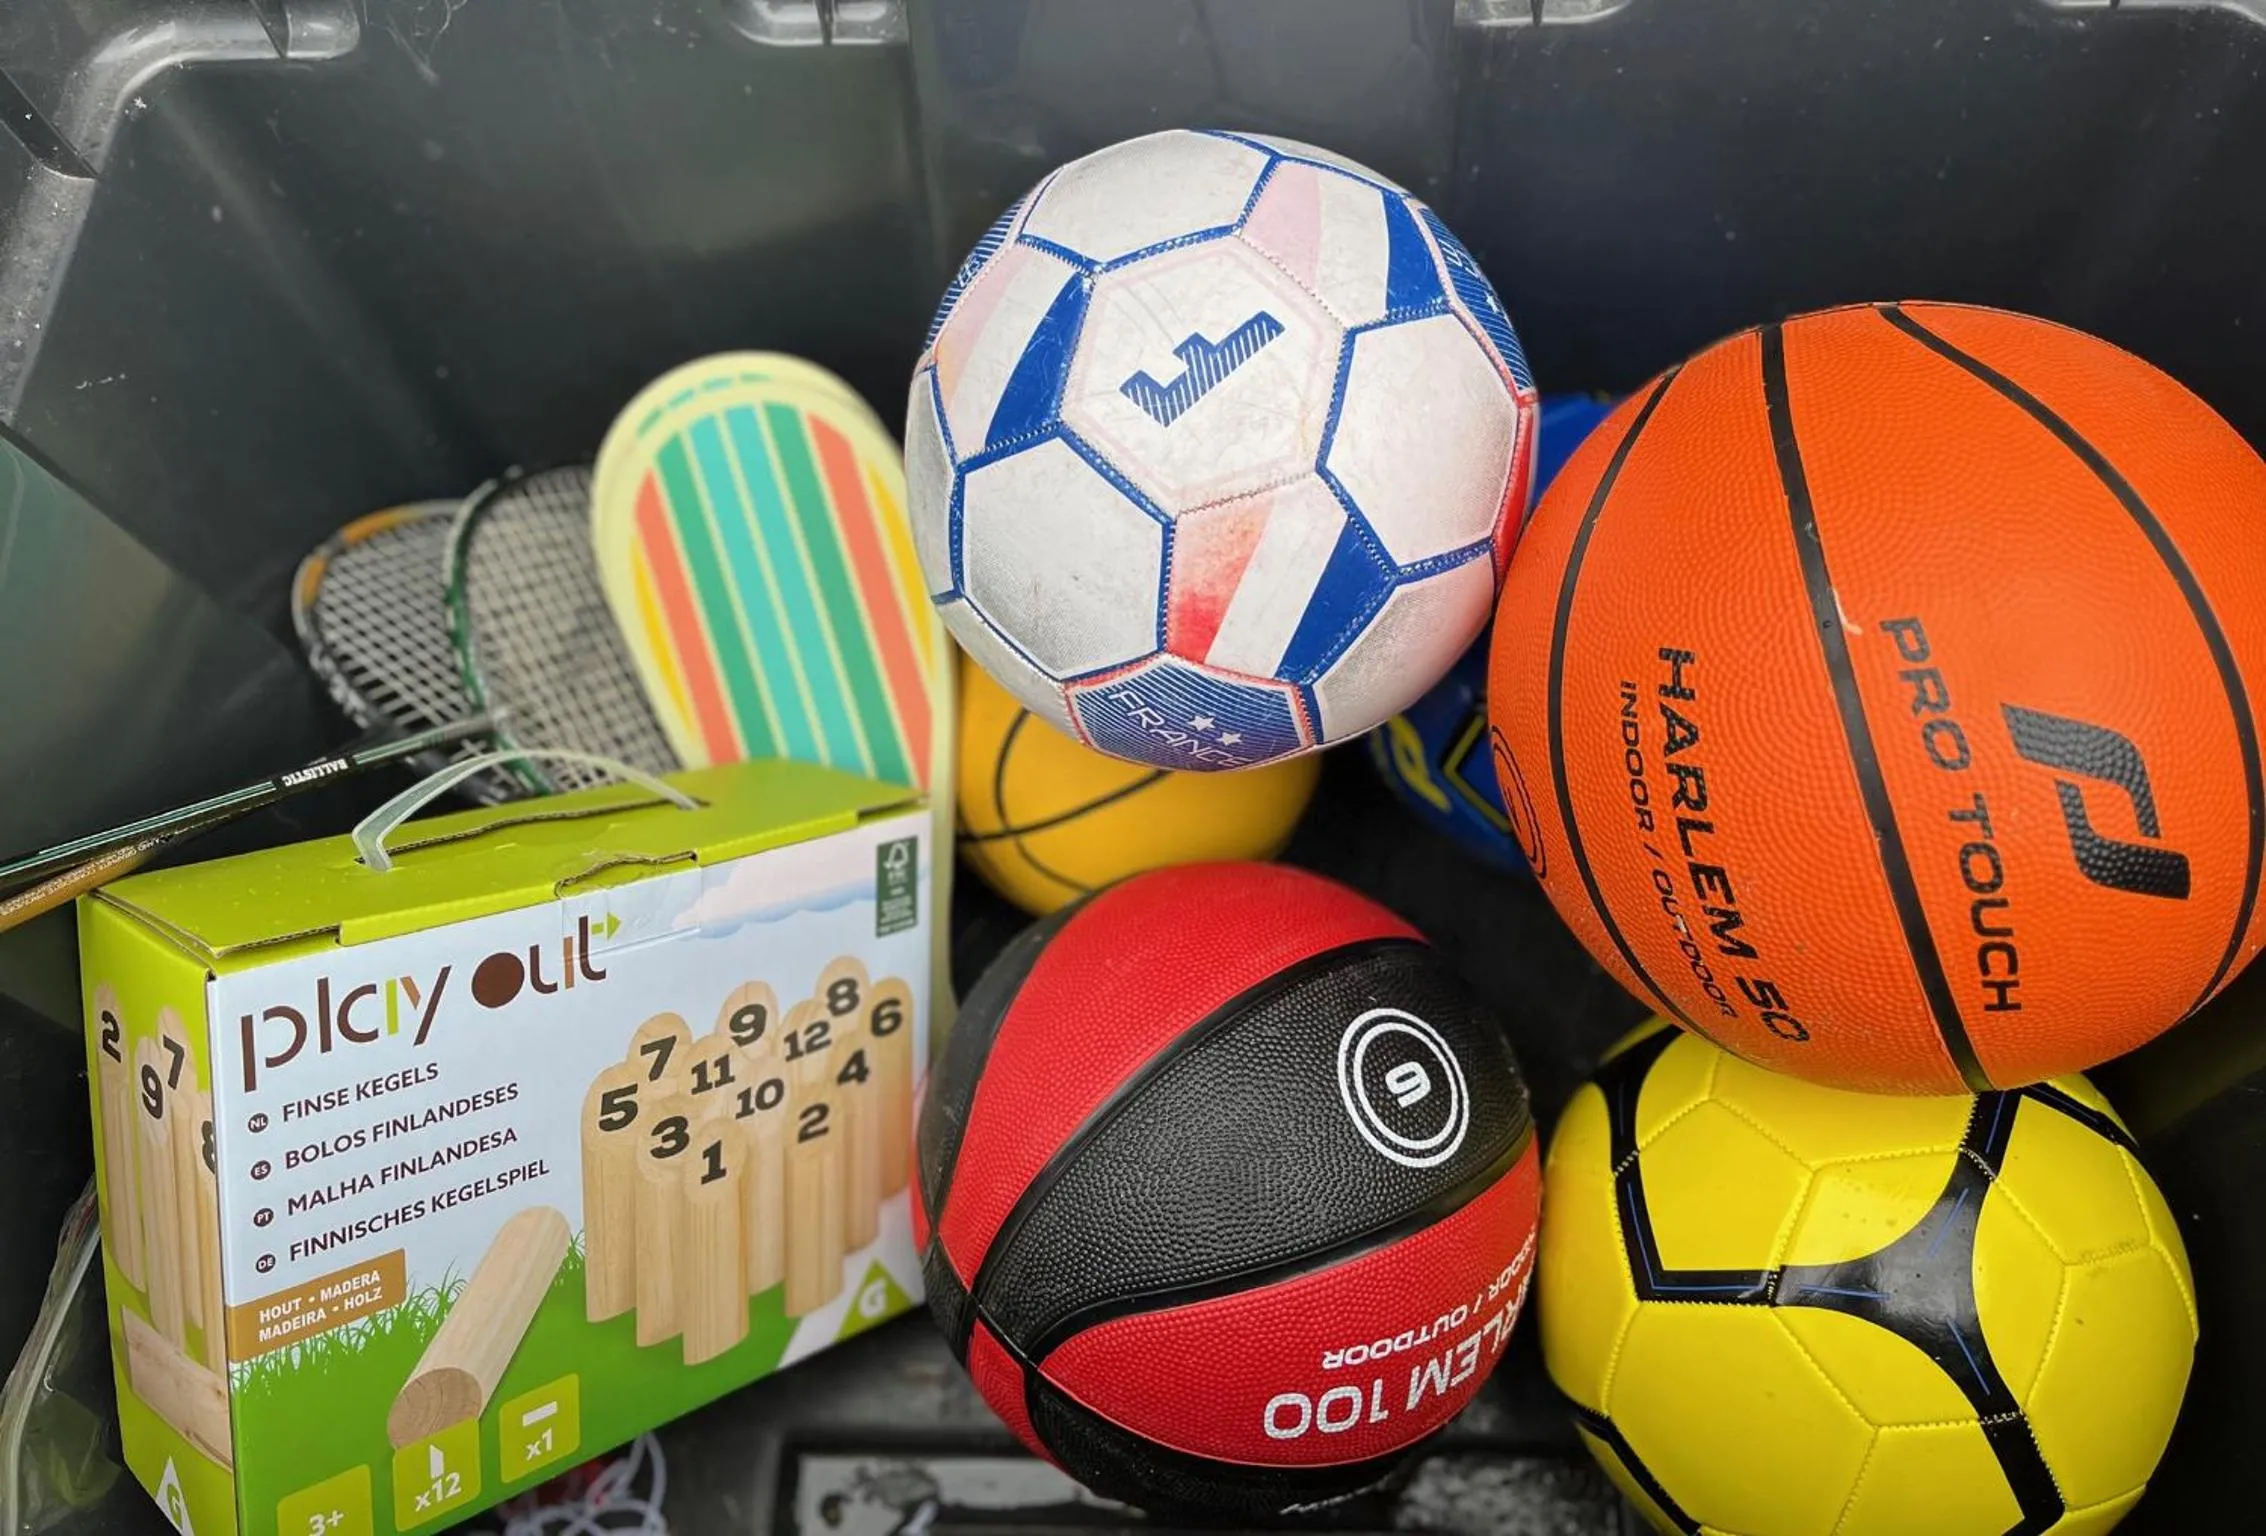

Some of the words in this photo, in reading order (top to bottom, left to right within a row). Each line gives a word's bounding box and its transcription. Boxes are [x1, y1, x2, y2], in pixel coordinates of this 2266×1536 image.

[1108, 689, 1253, 768] FRANCE
[281, 758, 348, 787] BALLISTIC
[1880, 616, 1972, 772] PRO
[1947, 791, 2022, 1013] TOUCH
[1620, 680, 1655, 834] INDOOR
[1653, 868, 1739, 1020] OUTDOOR
[1659, 647, 1759, 961] HARLEM
[1736, 975, 1811, 1044] 50
[241, 964, 452, 1093] play
[472, 915, 607, 1009] out
[827, 978, 859, 1018] 8
[871, 998, 903, 1038] 6
[102, 1010, 122, 1064] 2
[729, 1003, 767, 1048] 9
[784, 1020, 832, 1062] 12
[163, 1034, 185, 1091] 7
[640, 1035, 677, 1083] 7
[691, 1053, 736, 1096] 11
[836, 1049, 870, 1086] 4
[141, 1063, 164, 1120] 9
[249, 1116, 268, 1131] NL
[282, 1087, 350, 1122] FINSE
[355, 1062, 440, 1103] KEGELS
[599, 1083, 639, 1132] 5
[735, 1077, 784, 1120] 10
[254, 1162, 269, 1177] ES
[285, 1129, 367, 1170] BOLOS
[372, 1083, 519, 1143] FINLANDESES
[650, 1115, 690, 1160] 3
[797, 1103, 829, 1144] 2
[256, 1210, 272, 1224] PT
[287, 1173, 375, 1216] MALHA
[381, 1127, 519, 1185] FINLANDESA
[701, 1139, 727, 1185] 1
[257, 1256, 274, 1271] DE
[289, 1200, 426, 1262] FINNISCHES
[431, 1158, 551, 1213] KEGELSPIEL
[1489, 1221, 1536, 1301] DOOR
[258, 1297, 302, 1324] HOUT
[319, 1269, 381, 1303] MADERA
[258, 1307, 327, 1343] MADEIRA
[343, 1286, 383, 1311] HOLZ
[1322, 1304, 1468, 1370] OUTDOOR
[1406, 1250, 1536, 1412] RLEM
[1263, 1378, 1390, 1440] 100
[526, 1427, 553, 1461] x1
[414, 1471, 463, 1512] x12
[308, 1509, 345, 1536] 3+
